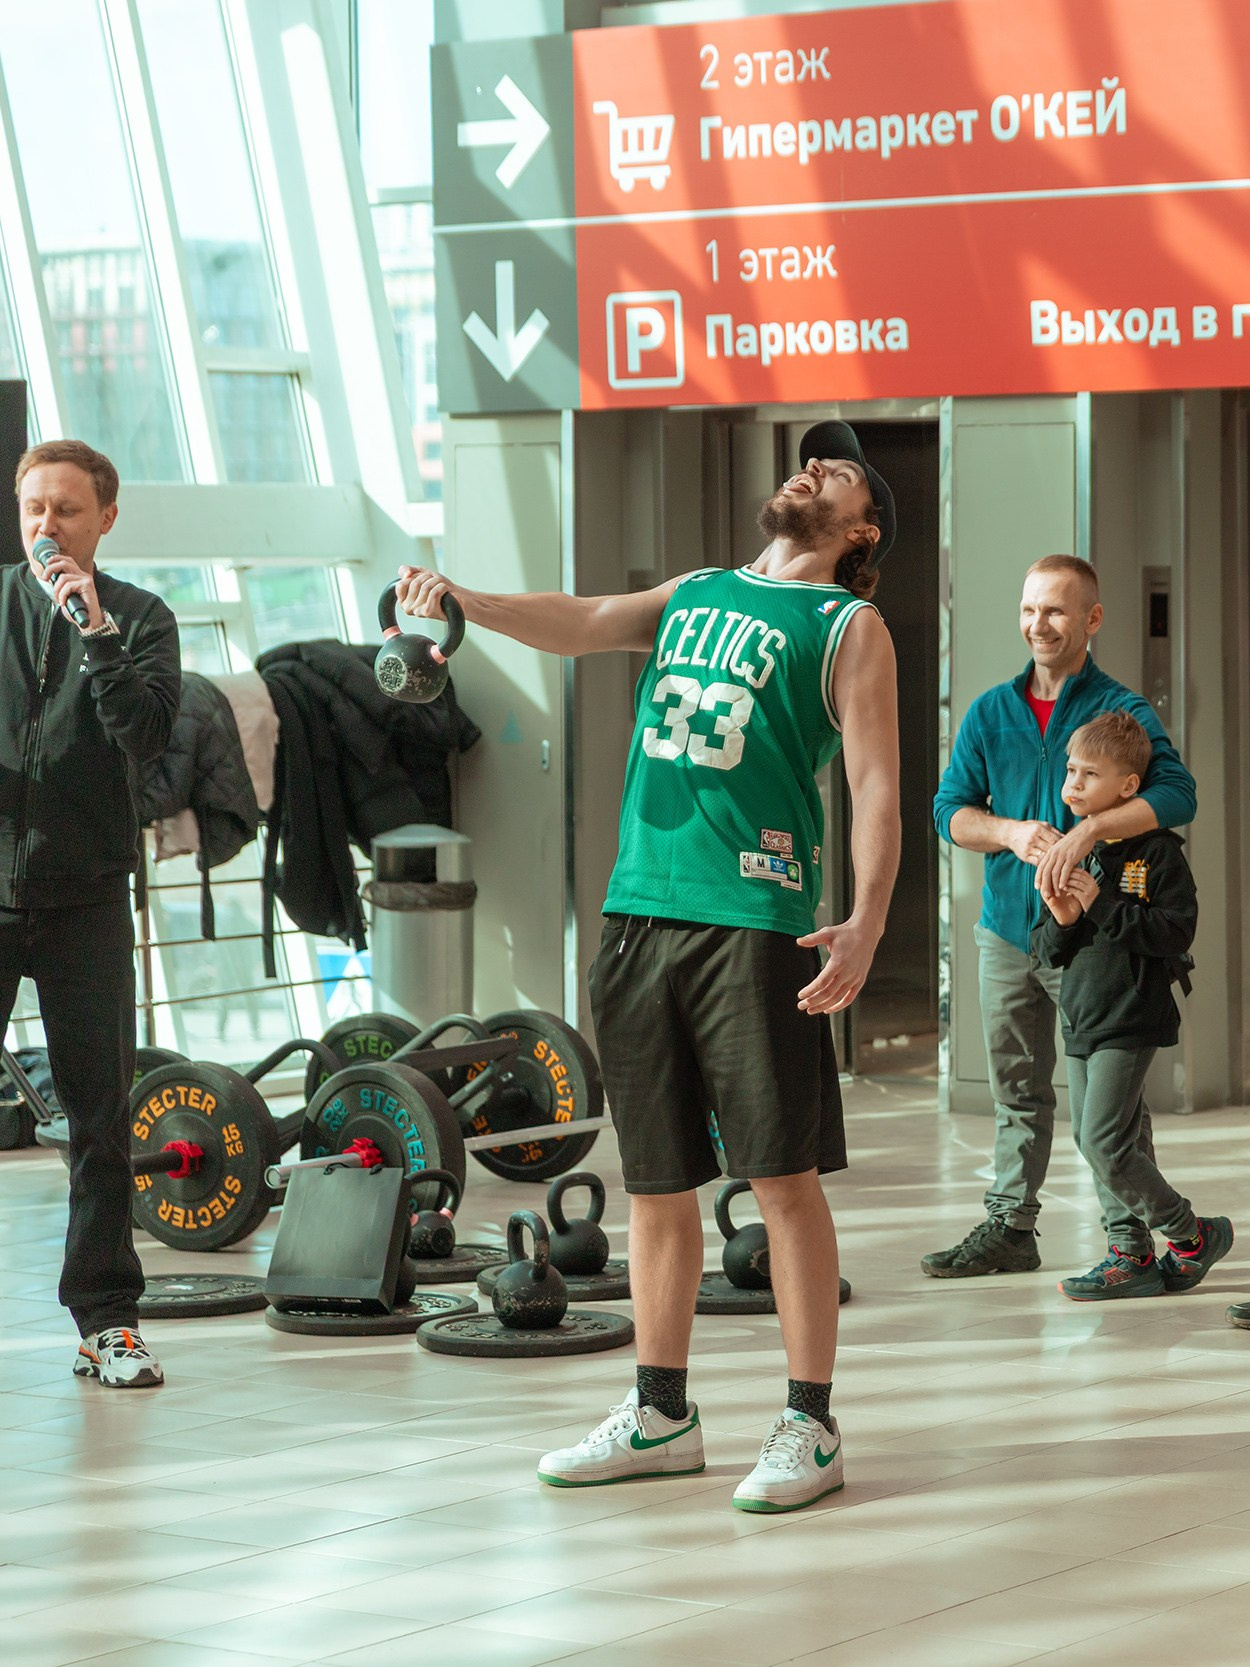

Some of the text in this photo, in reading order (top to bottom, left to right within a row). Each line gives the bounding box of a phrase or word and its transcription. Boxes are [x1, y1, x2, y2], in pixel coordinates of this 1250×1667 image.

[699, 43, 831, 90] 2 этаж
[700, 109, 978, 165] Гипермаркет
[705, 239, 838, 283] 1 этаж
[705, 314, 909, 367] Парковка
[1030, 300, 1181, 347] Выход
[1192, 305, 1218, 339] в
[656, 607, 787, 689] CELTICS
[642, 674, 755, 771] 33
[756, 857, 766, 868] M
[132, 1085, 218, 1141] STECTER
[221, 1122, 241, 1144] 15
[226, 1141, 244, 1157] KG
[157, 1175, 242, 1230] STECTER
